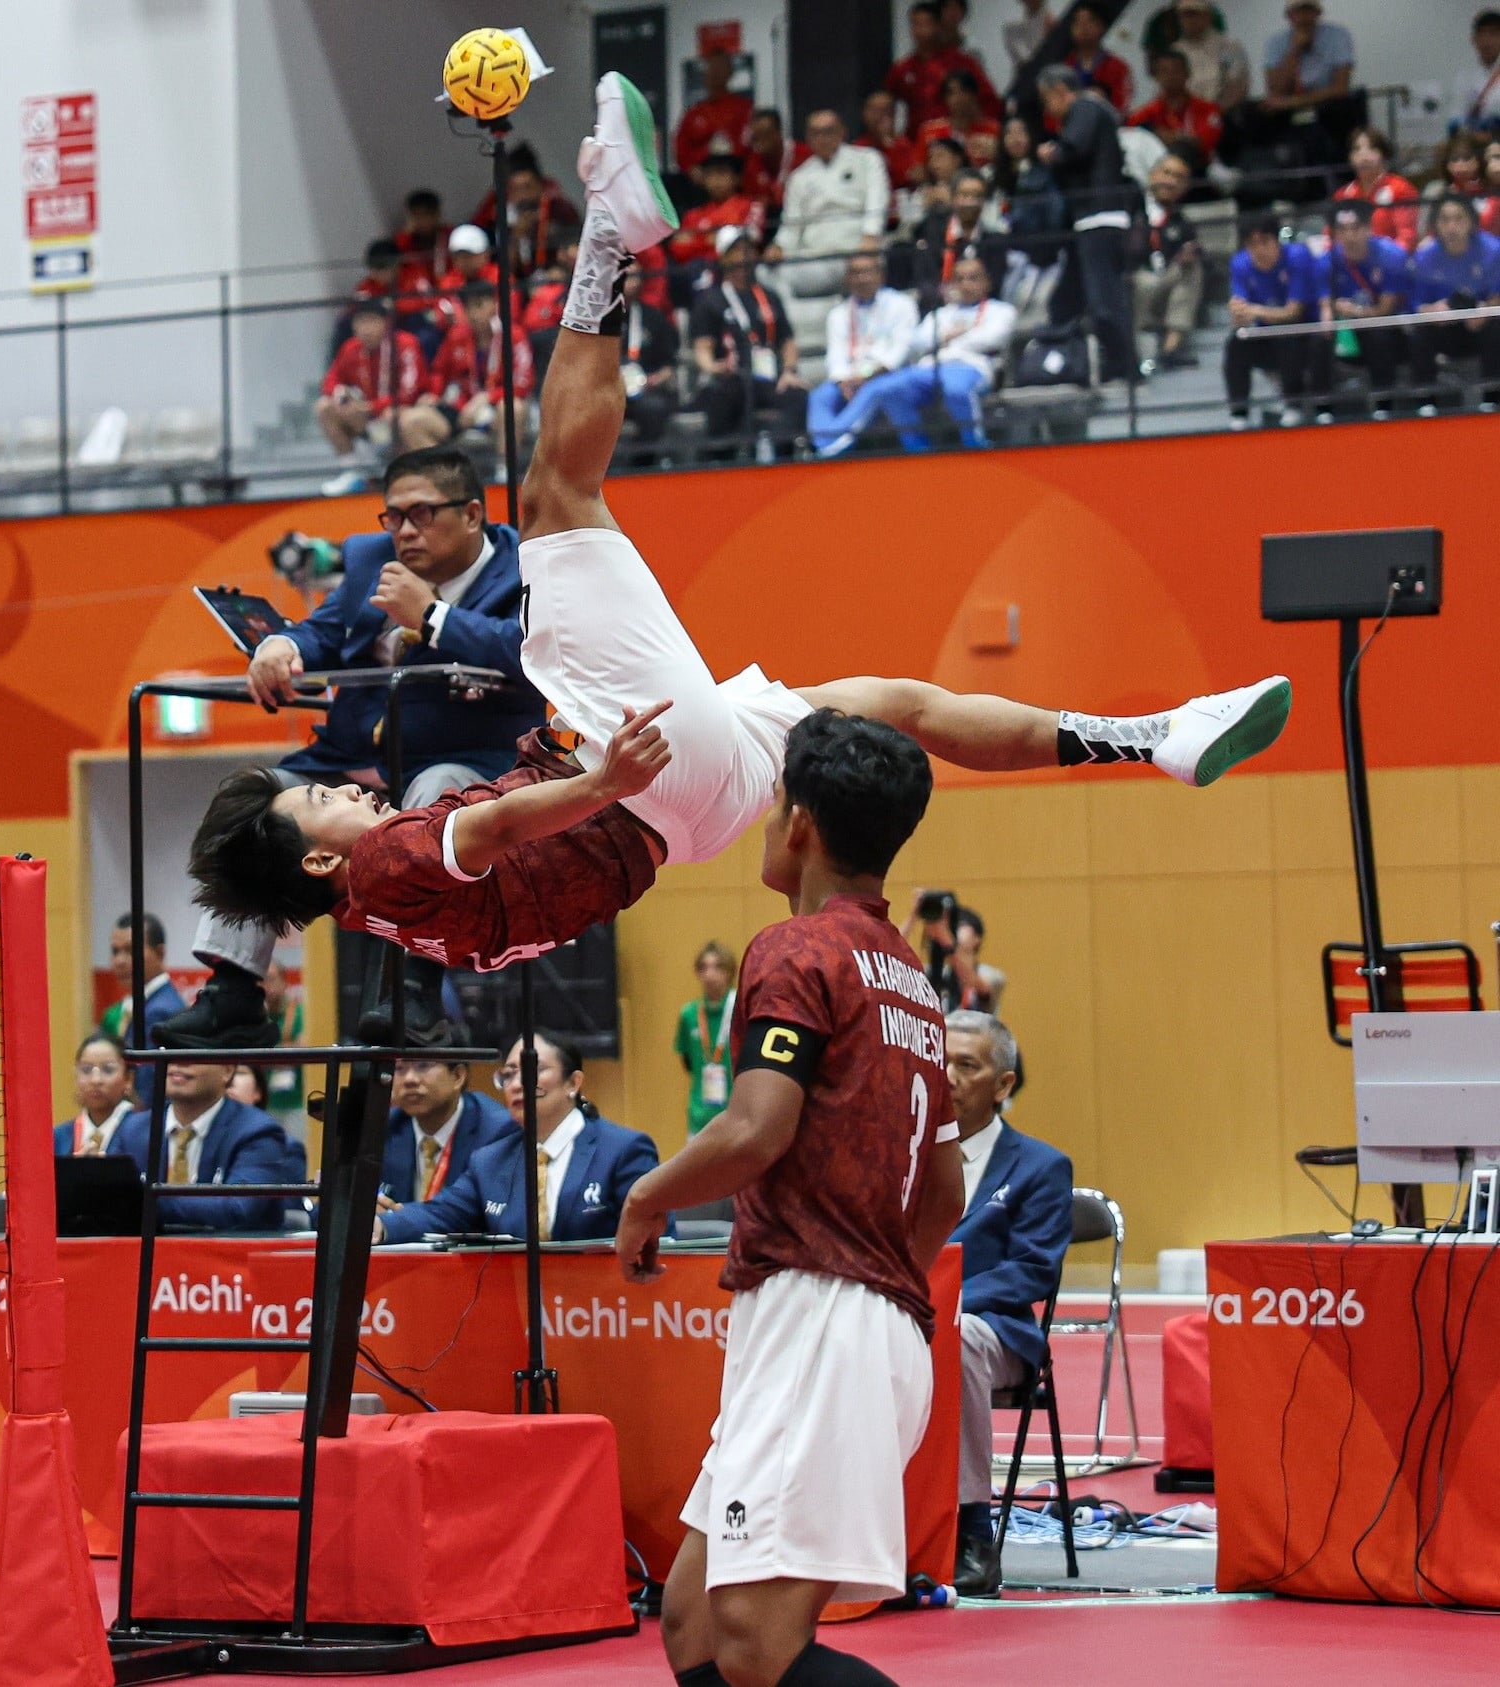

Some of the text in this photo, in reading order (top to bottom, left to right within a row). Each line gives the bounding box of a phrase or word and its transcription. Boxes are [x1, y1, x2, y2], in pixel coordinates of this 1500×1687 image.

[760, 1026, 800, 1064] C
[1365, 1027, 1412, 1040] Lenovo
[900, 1072, 929, 1213] 3
[1251, 1286, 1365, 1327] 2026
